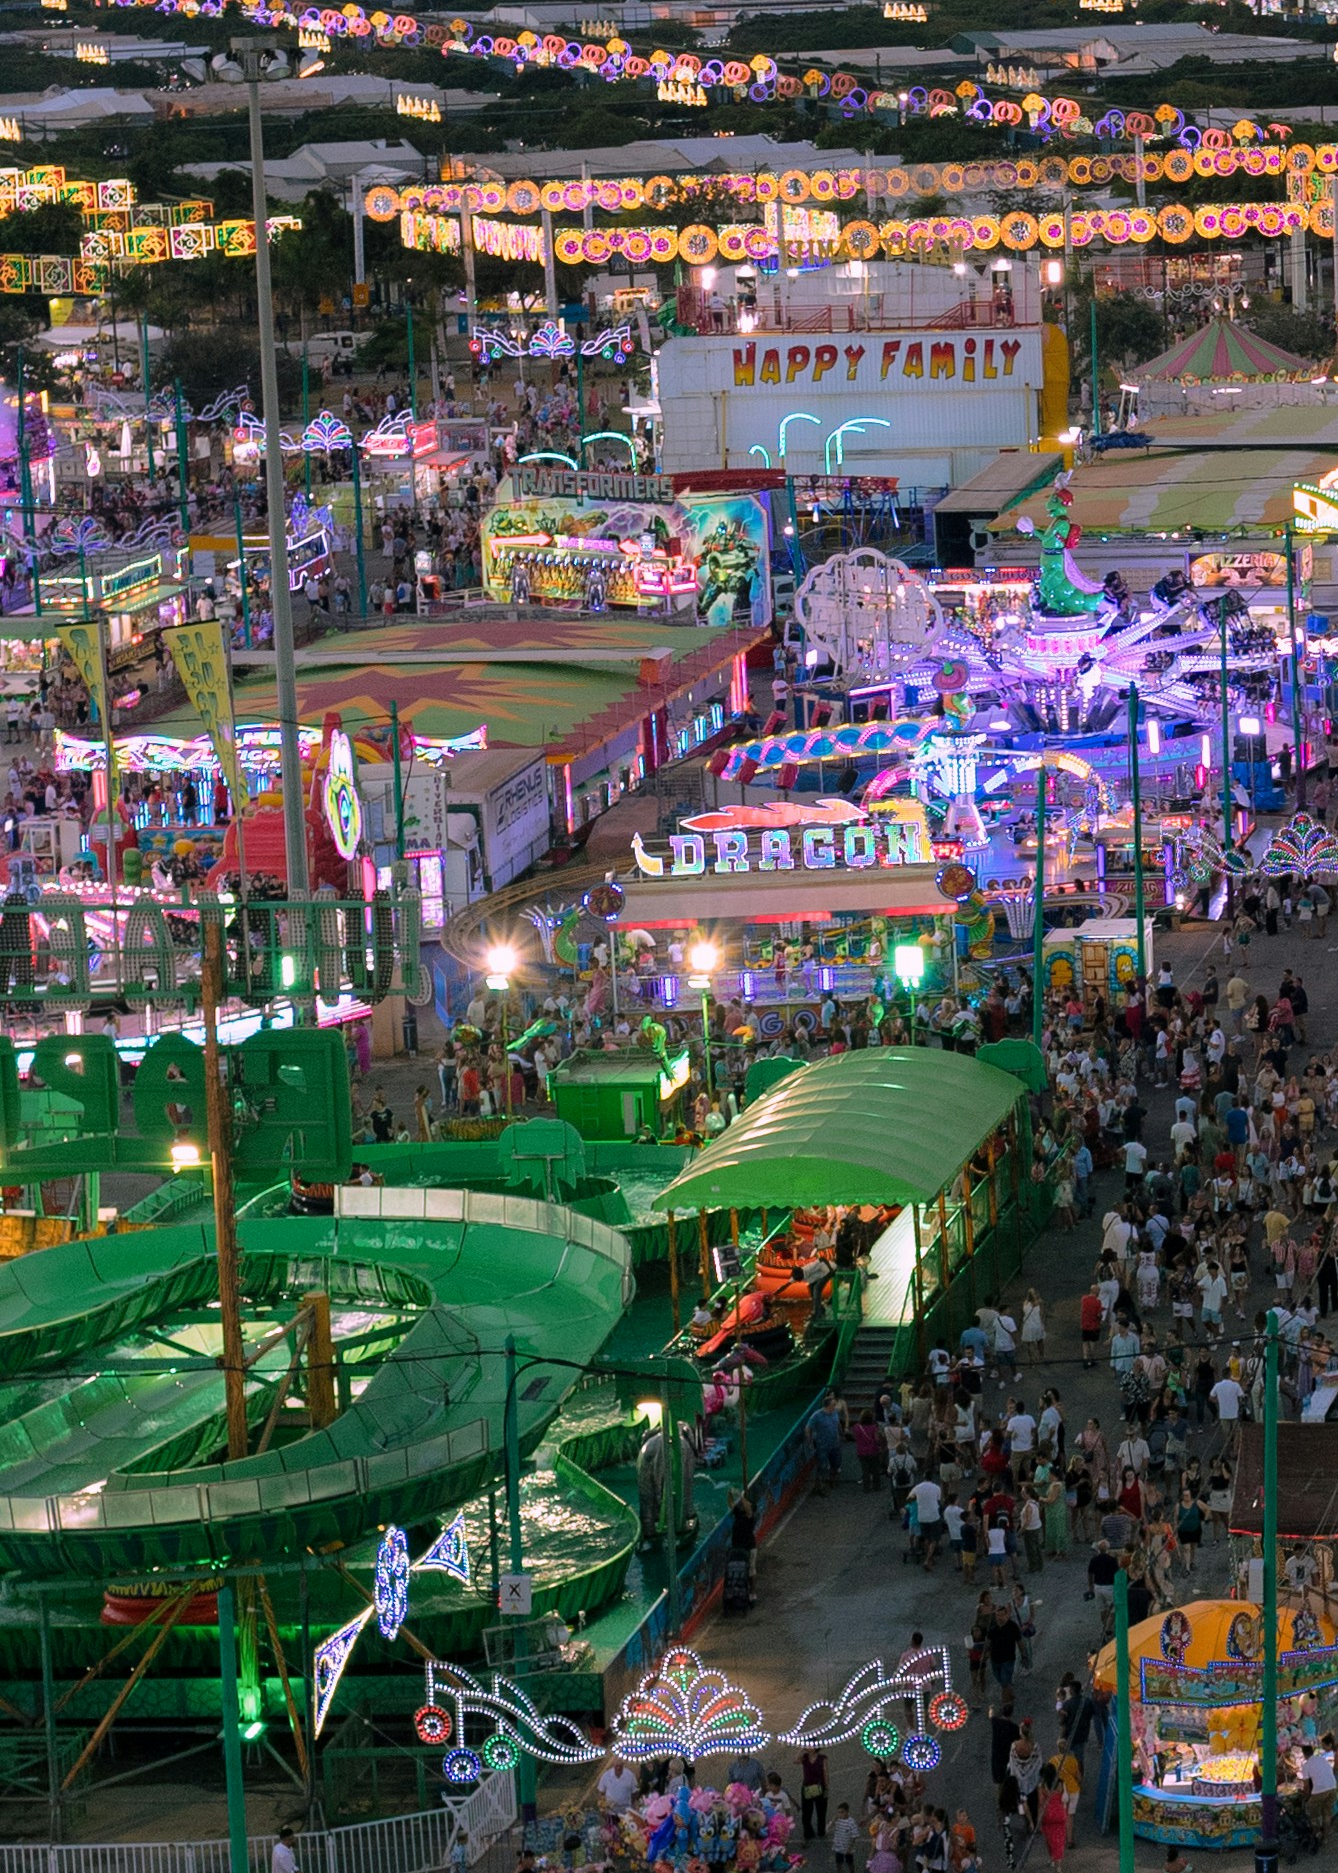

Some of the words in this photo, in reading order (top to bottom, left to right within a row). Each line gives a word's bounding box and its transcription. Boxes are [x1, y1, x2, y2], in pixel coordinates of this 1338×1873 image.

[732, 341, 866, 386] HAPPY
[880, 337, 1021, 383] FAMILY
[510, 469, 676, 506] TRANSFORMERS
[505, 768, 542, 806] RHENUS
[670, 825, 923, 875] DRAGON
